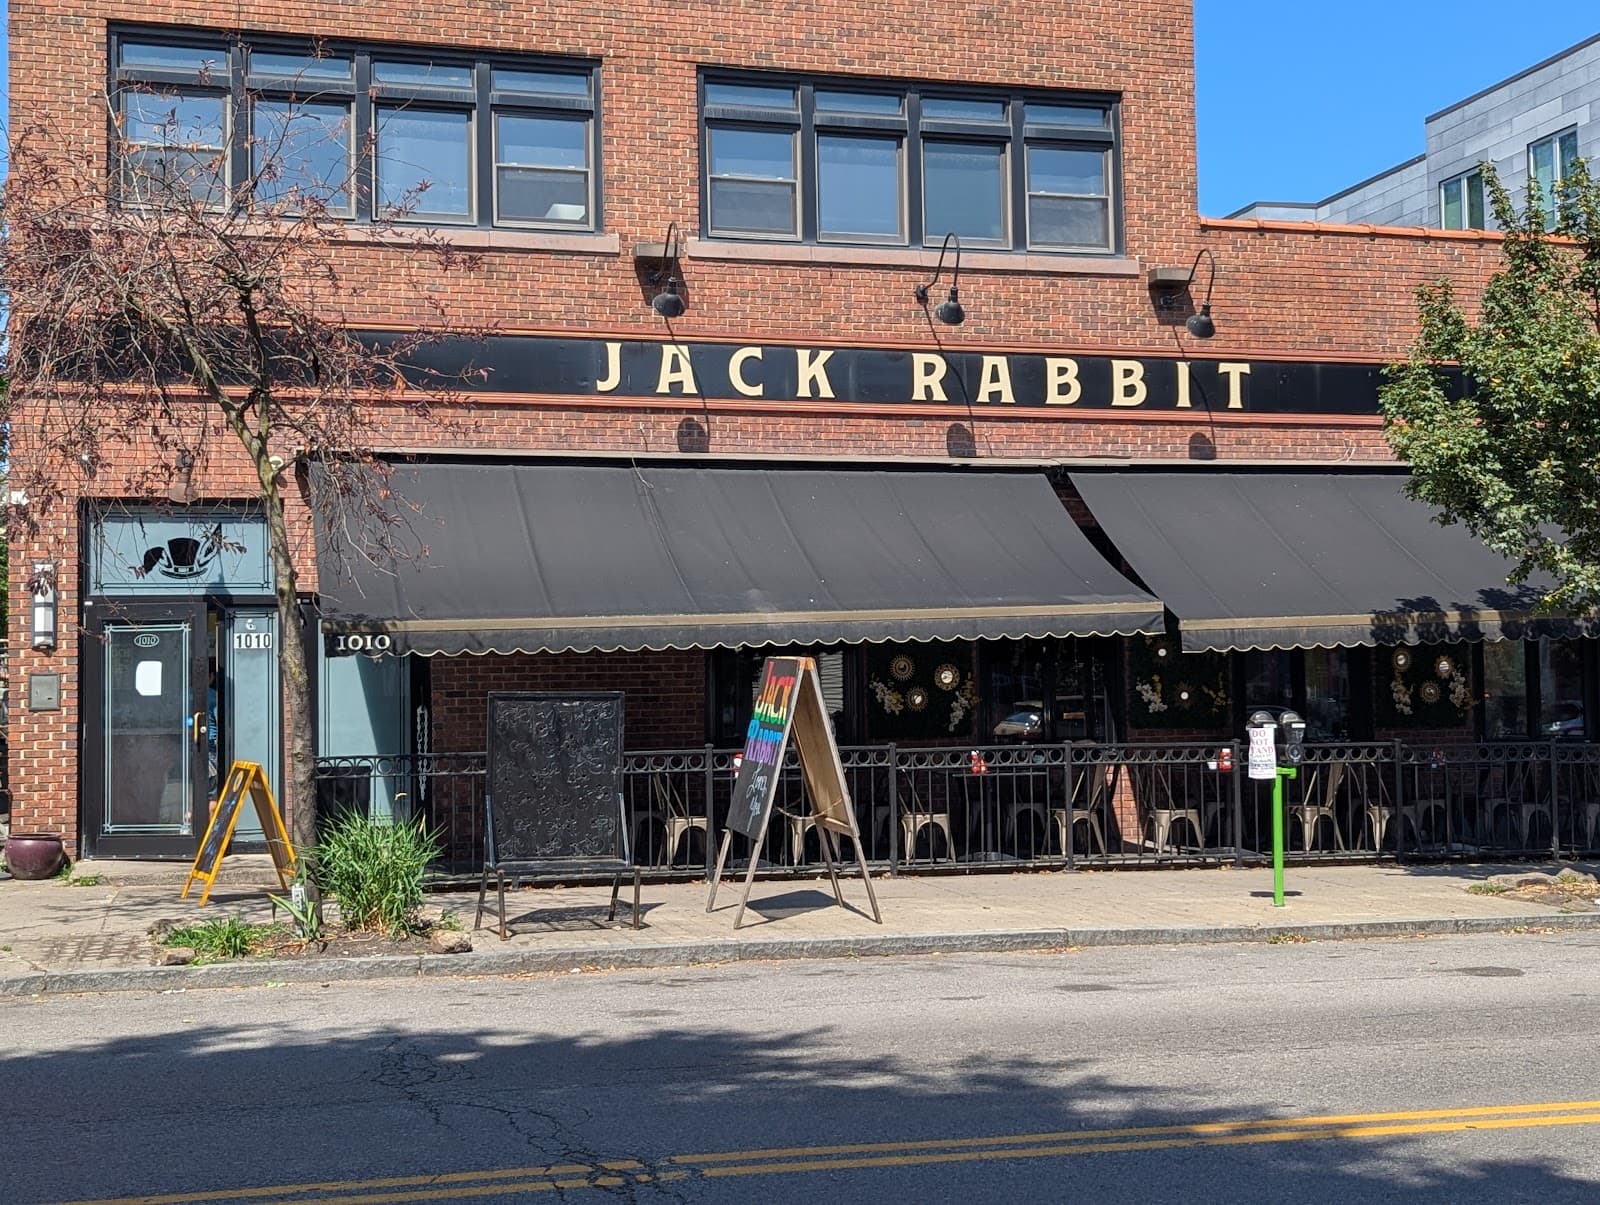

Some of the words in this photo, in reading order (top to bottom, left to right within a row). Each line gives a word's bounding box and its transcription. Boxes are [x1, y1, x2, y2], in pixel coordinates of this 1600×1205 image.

[596, 342, 835, 399] JACK
[911, 352, 1251, 409] RABBIT
[138, 634, 157, 645] 1010
[236, 633, 271, 648] 1010
[753, 661, 795, 725] JACK
[745, 718, 783, 766] RABBIT
[1252, 730, 1266, 738] DO
